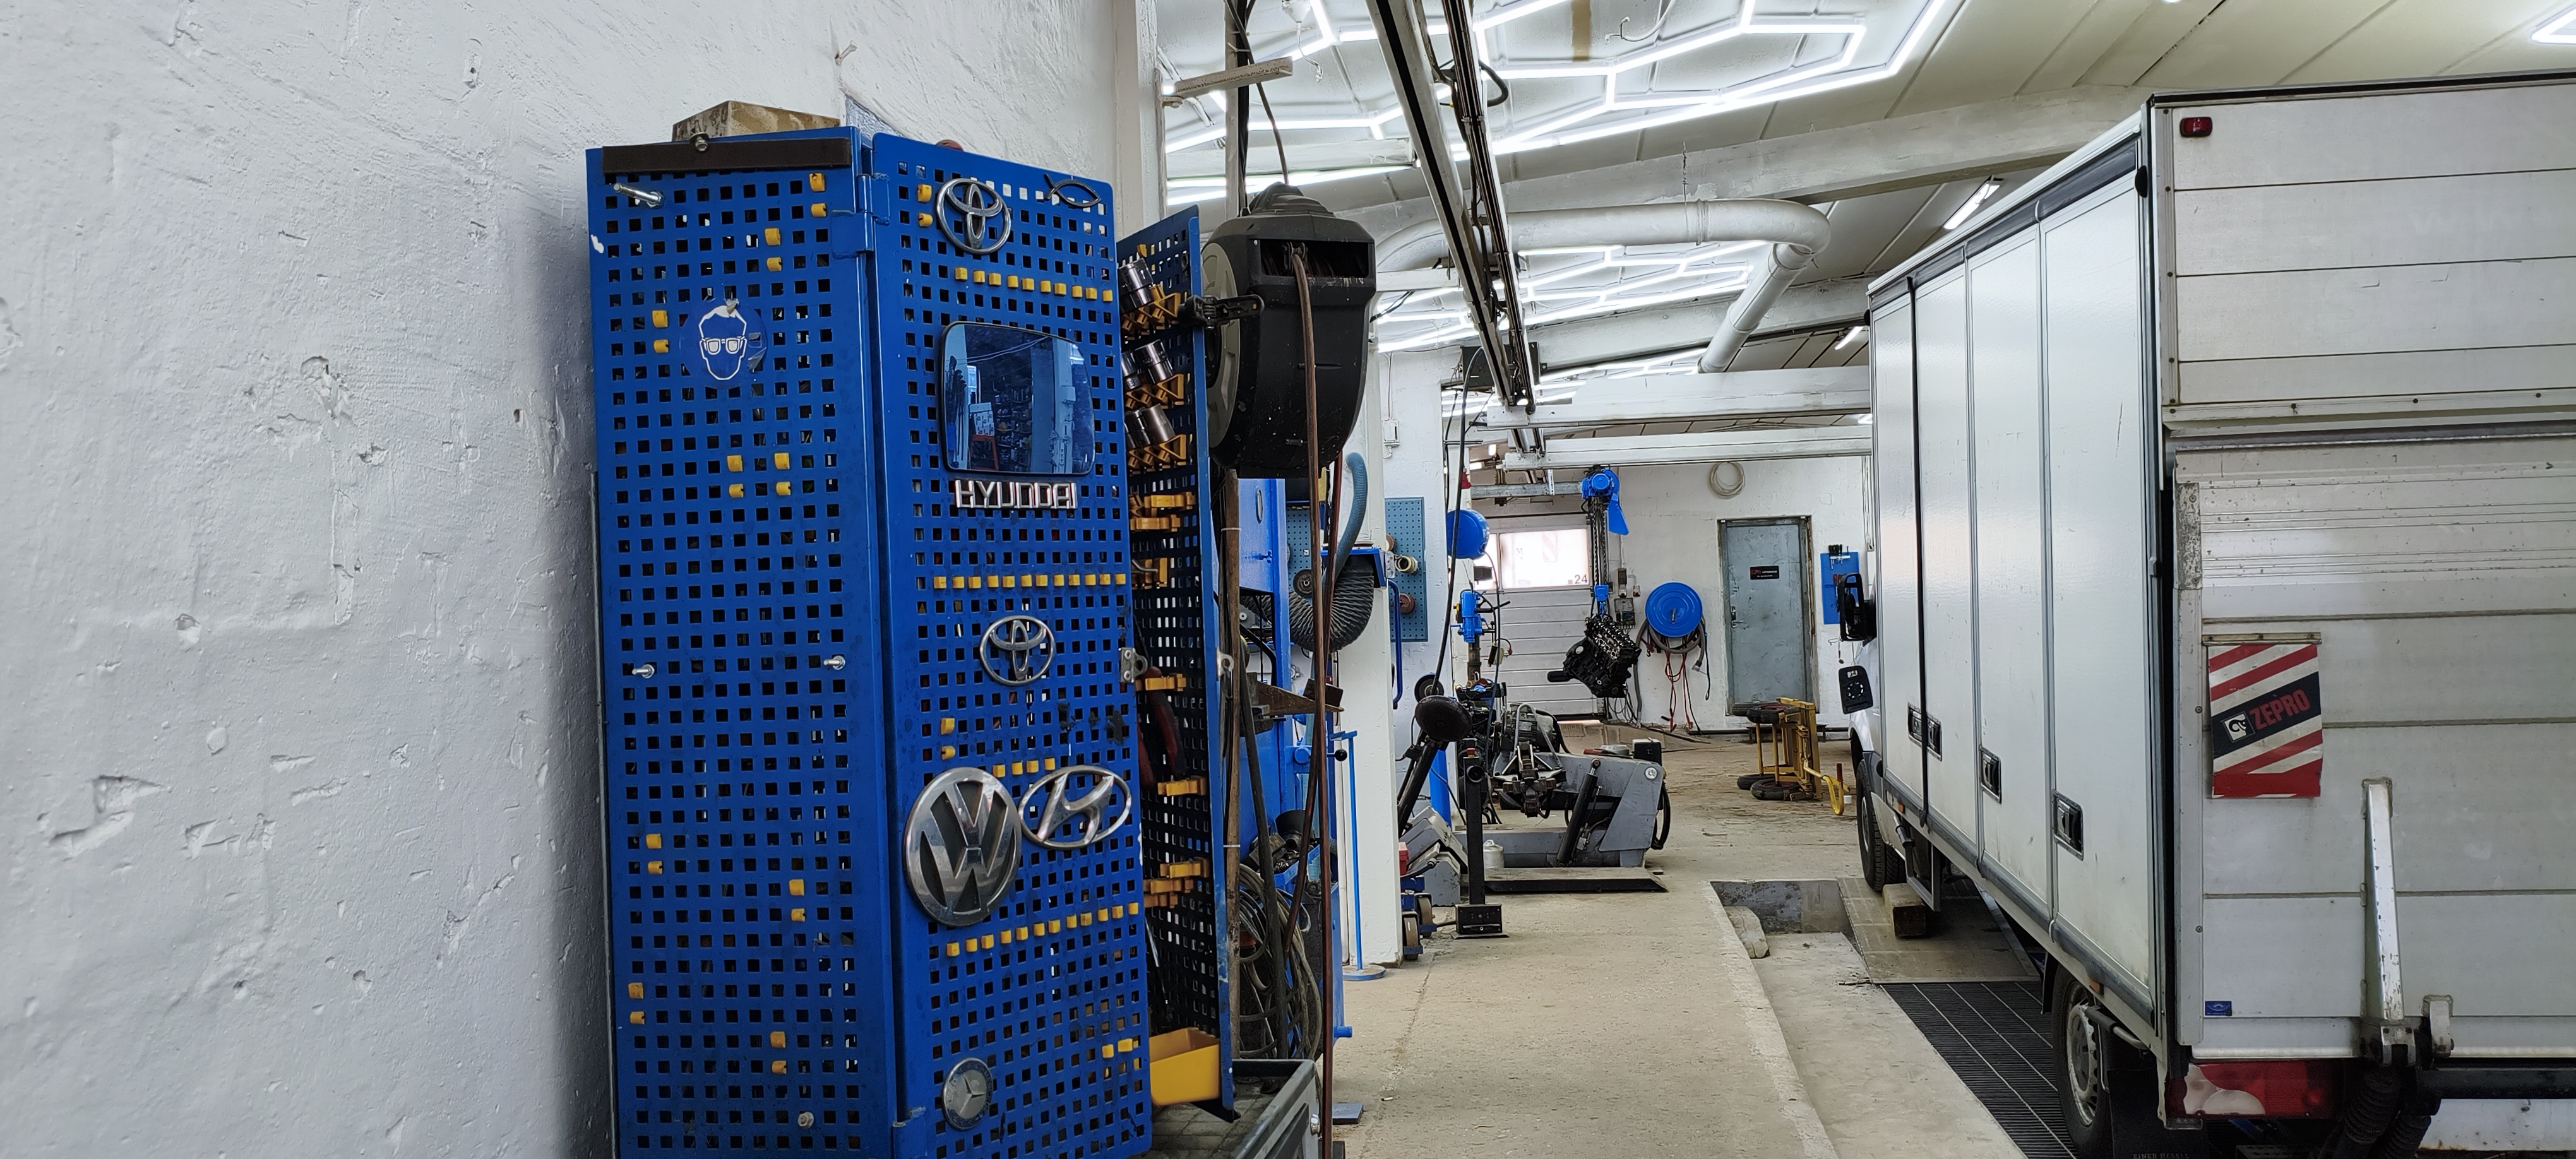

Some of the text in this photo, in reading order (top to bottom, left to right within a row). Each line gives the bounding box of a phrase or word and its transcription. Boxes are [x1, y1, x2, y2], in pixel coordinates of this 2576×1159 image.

[955, 478, 1078, 509] HYUNDAI
[1574, 574, 1588, 584] 24
[2249, 688, 2311, 730] ZEPRO
